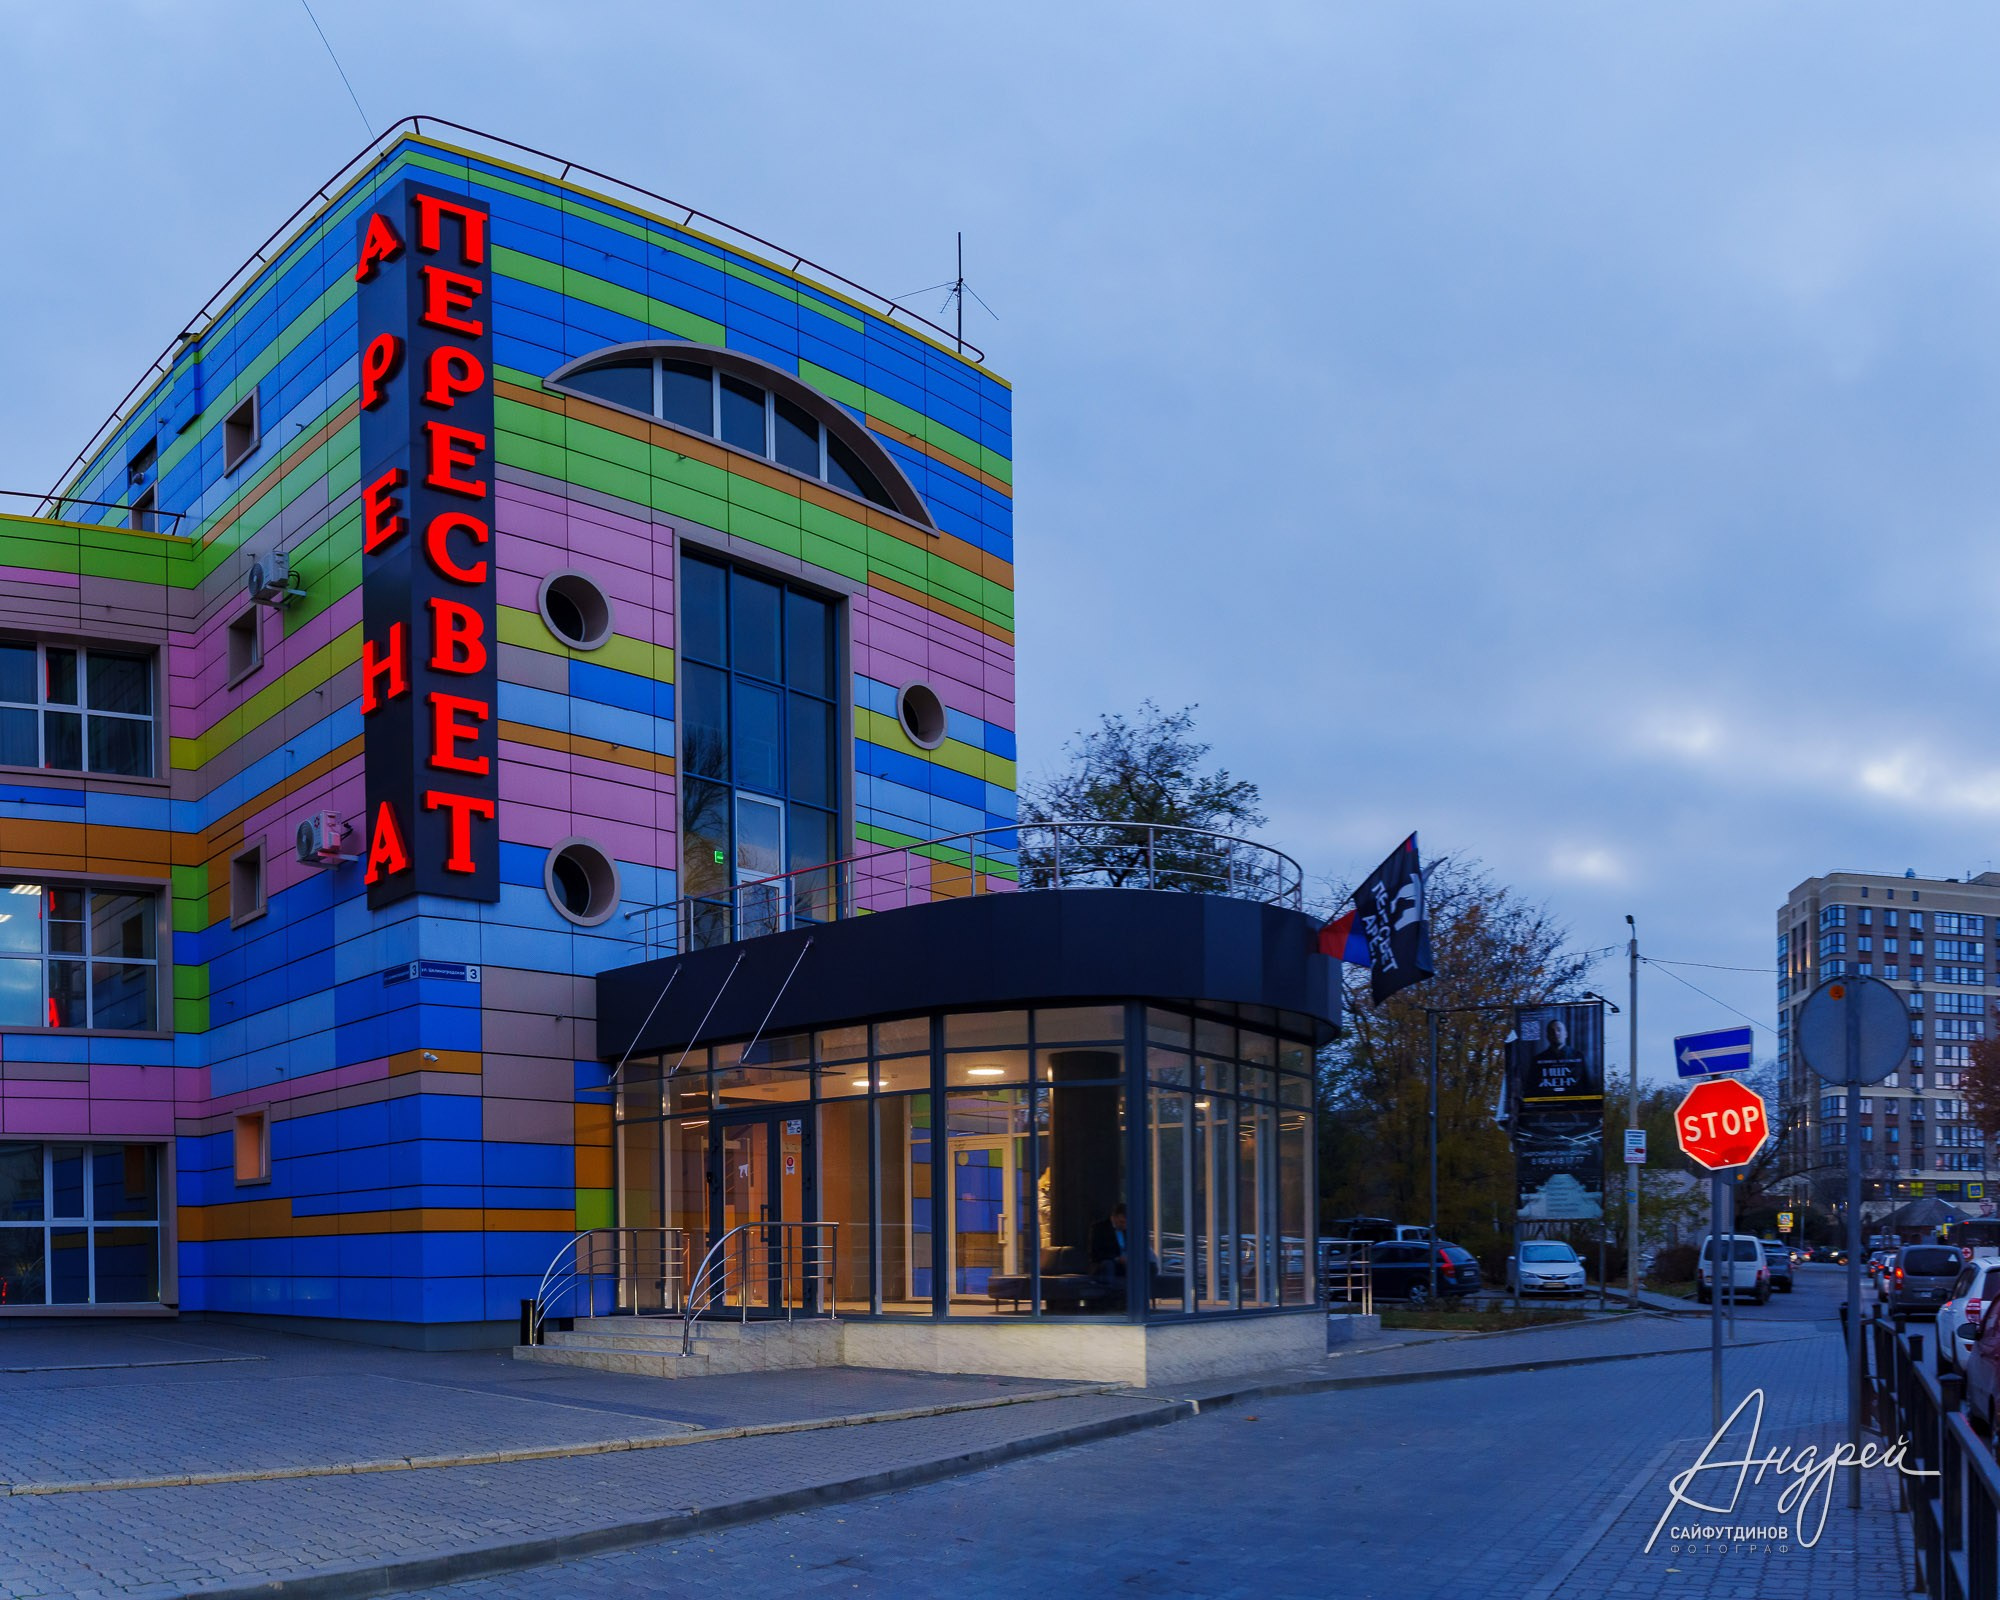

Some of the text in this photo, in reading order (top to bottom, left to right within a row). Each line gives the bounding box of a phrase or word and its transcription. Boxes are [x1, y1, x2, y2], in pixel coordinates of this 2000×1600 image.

[355, 212, 409, 886] АРЕНА
[414, 193, 495, 875] ПЕРЕСВЕТ
[412, 964, 417, 976] 3
[470, 968, 478, 979] 3
[1684, 1106, 1760, 1142] STOP
